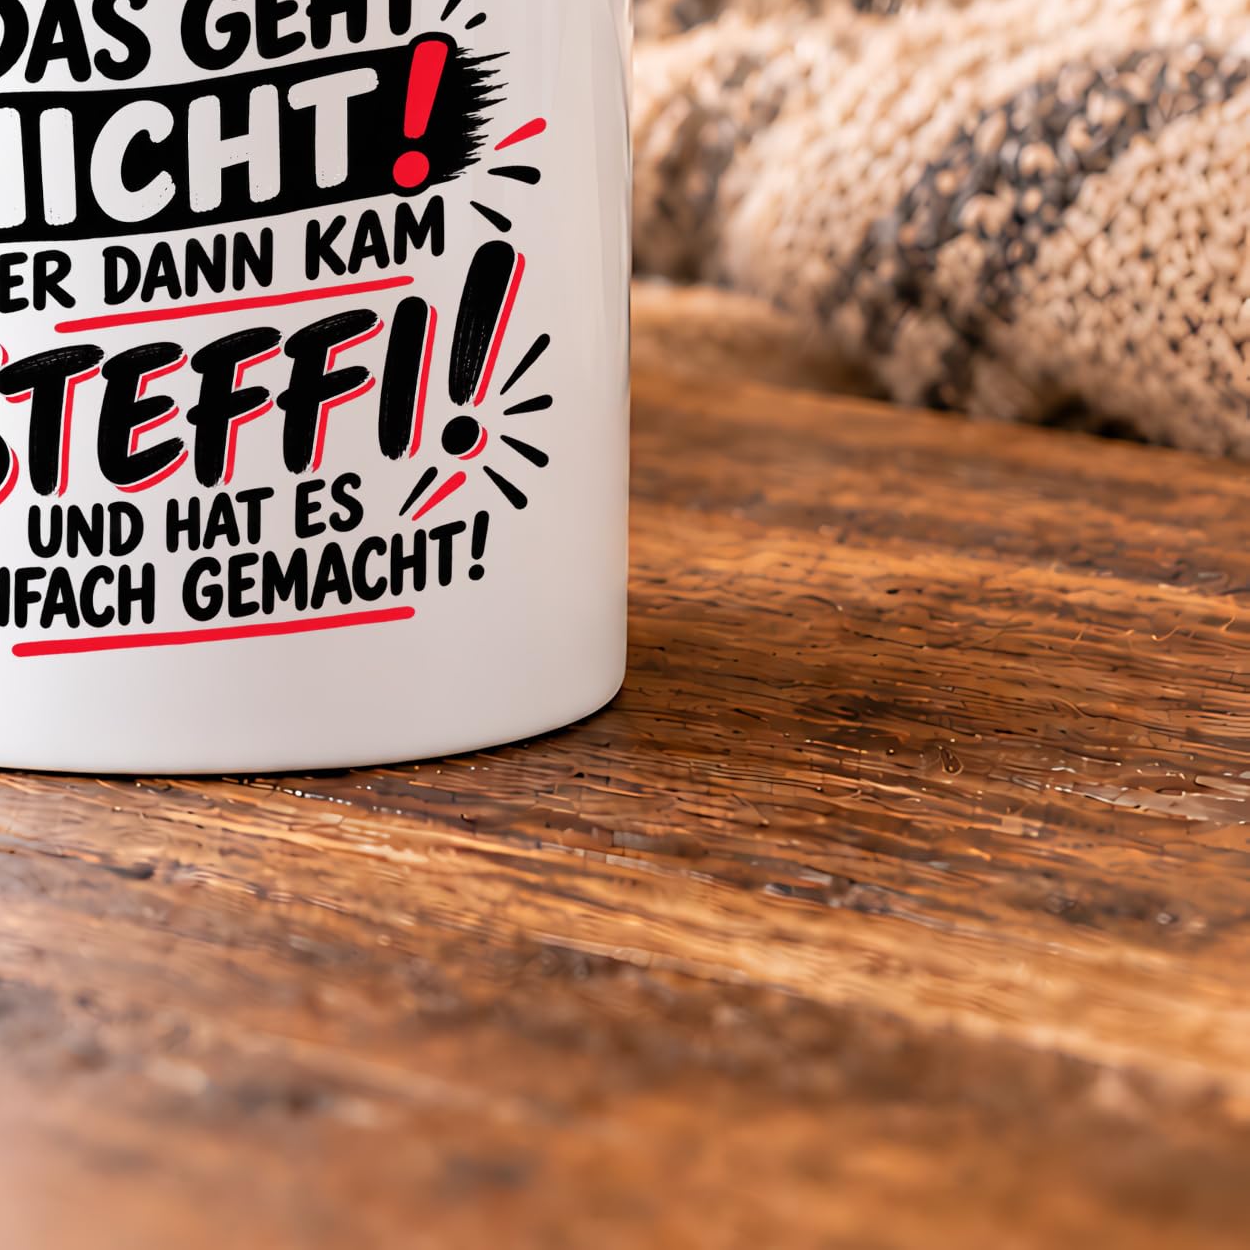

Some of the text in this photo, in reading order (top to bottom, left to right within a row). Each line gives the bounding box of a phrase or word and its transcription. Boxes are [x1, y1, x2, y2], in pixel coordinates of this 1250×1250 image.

[102, 227, 274, 306] DANN
[305, 194, 445, 281] KAM
[27, 472, 364, 559] UND HAT ES
[181, 510, 490, 622] GEMACHT!
